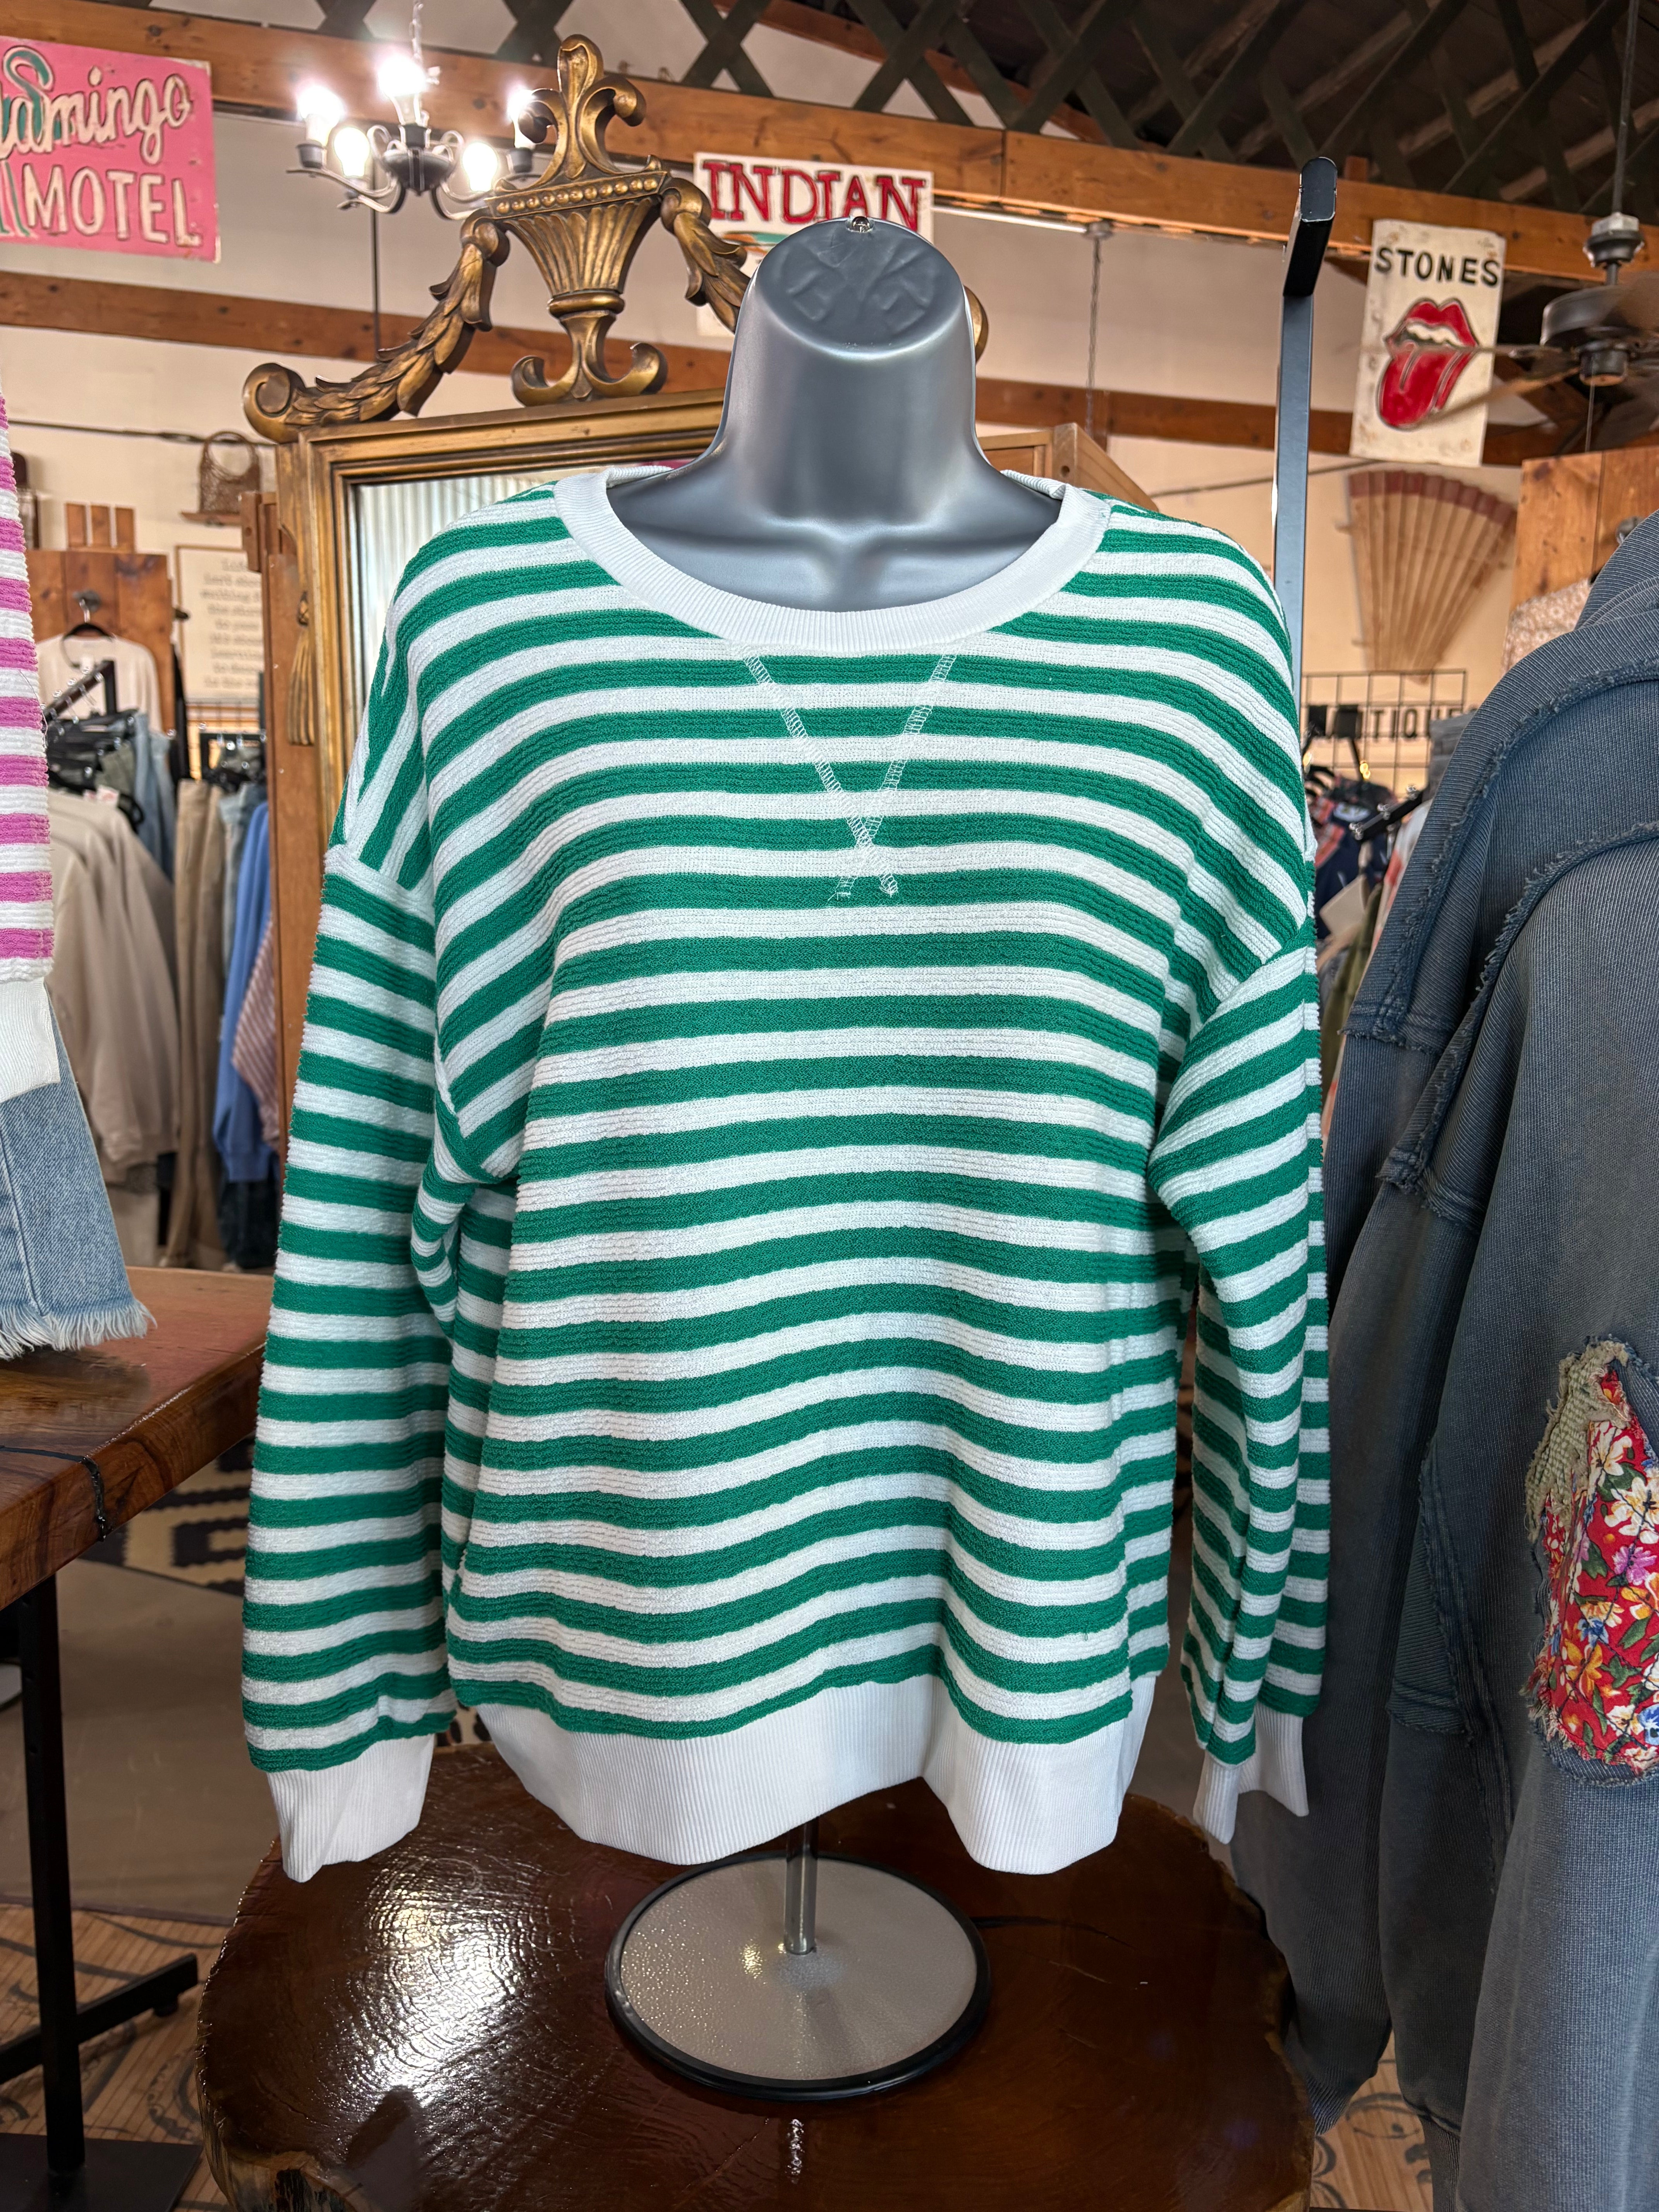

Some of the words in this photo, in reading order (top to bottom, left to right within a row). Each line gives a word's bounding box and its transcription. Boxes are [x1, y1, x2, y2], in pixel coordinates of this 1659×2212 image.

[0, 64, 193, 166] amingo
[22, 163, 202, 247] MOTEL
[702, 159, 927, 232] INDIAN
[1374, 246, 1501, 287] STONES
